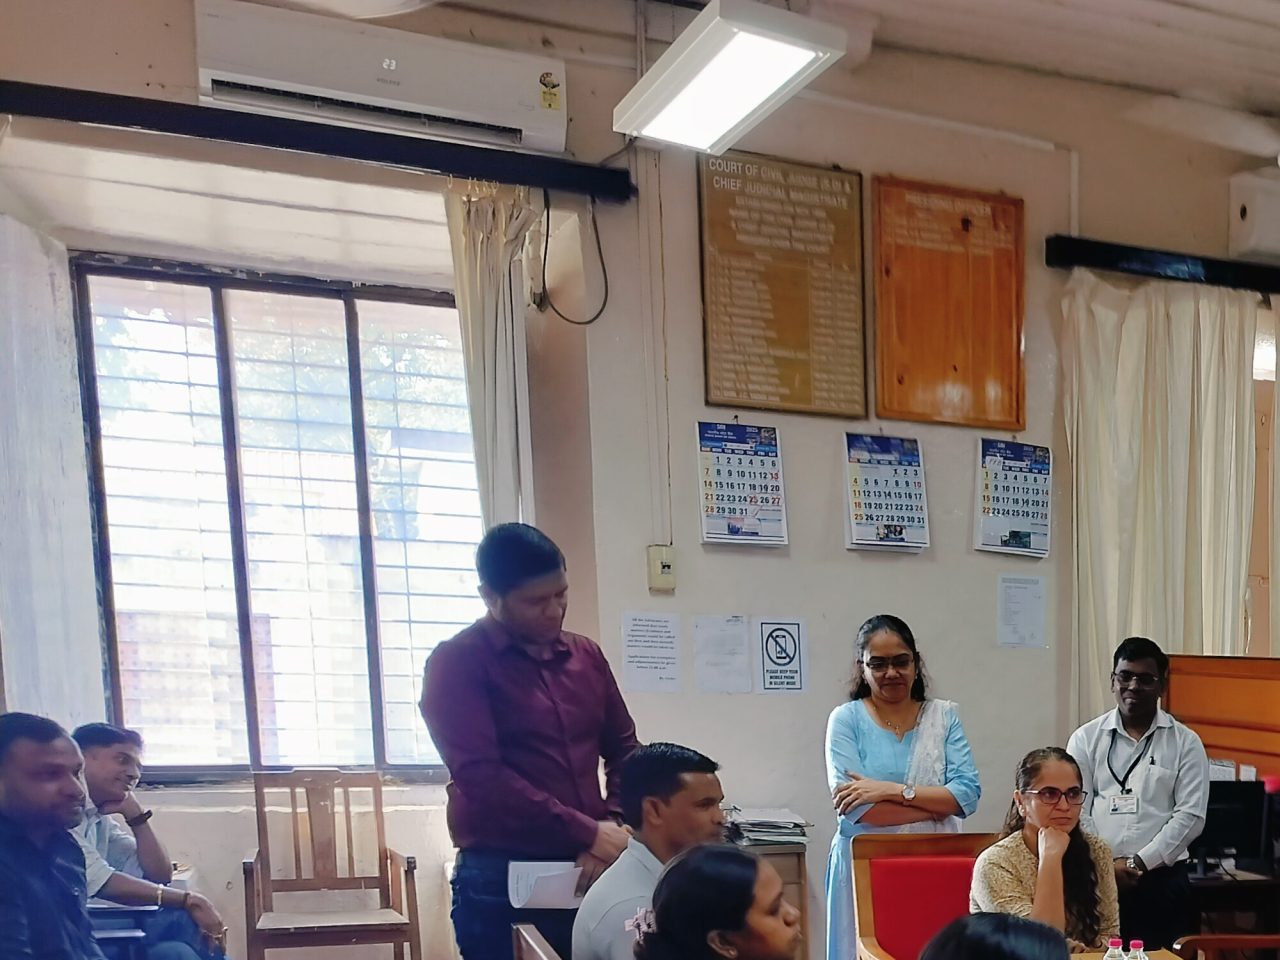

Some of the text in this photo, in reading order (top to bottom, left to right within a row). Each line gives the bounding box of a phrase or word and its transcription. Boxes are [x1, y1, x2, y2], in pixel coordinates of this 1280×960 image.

[382, 58, 397, 70] 23
[709, 159, 743, 175] COURT
[745, 164, 758, 177] OF
[713, 176, 742, 190] CHIEF
[1012, 486, 1019, 494] 11
[771, 497, 780, 505] 27
[1022, 498, 1029, 507] 19
